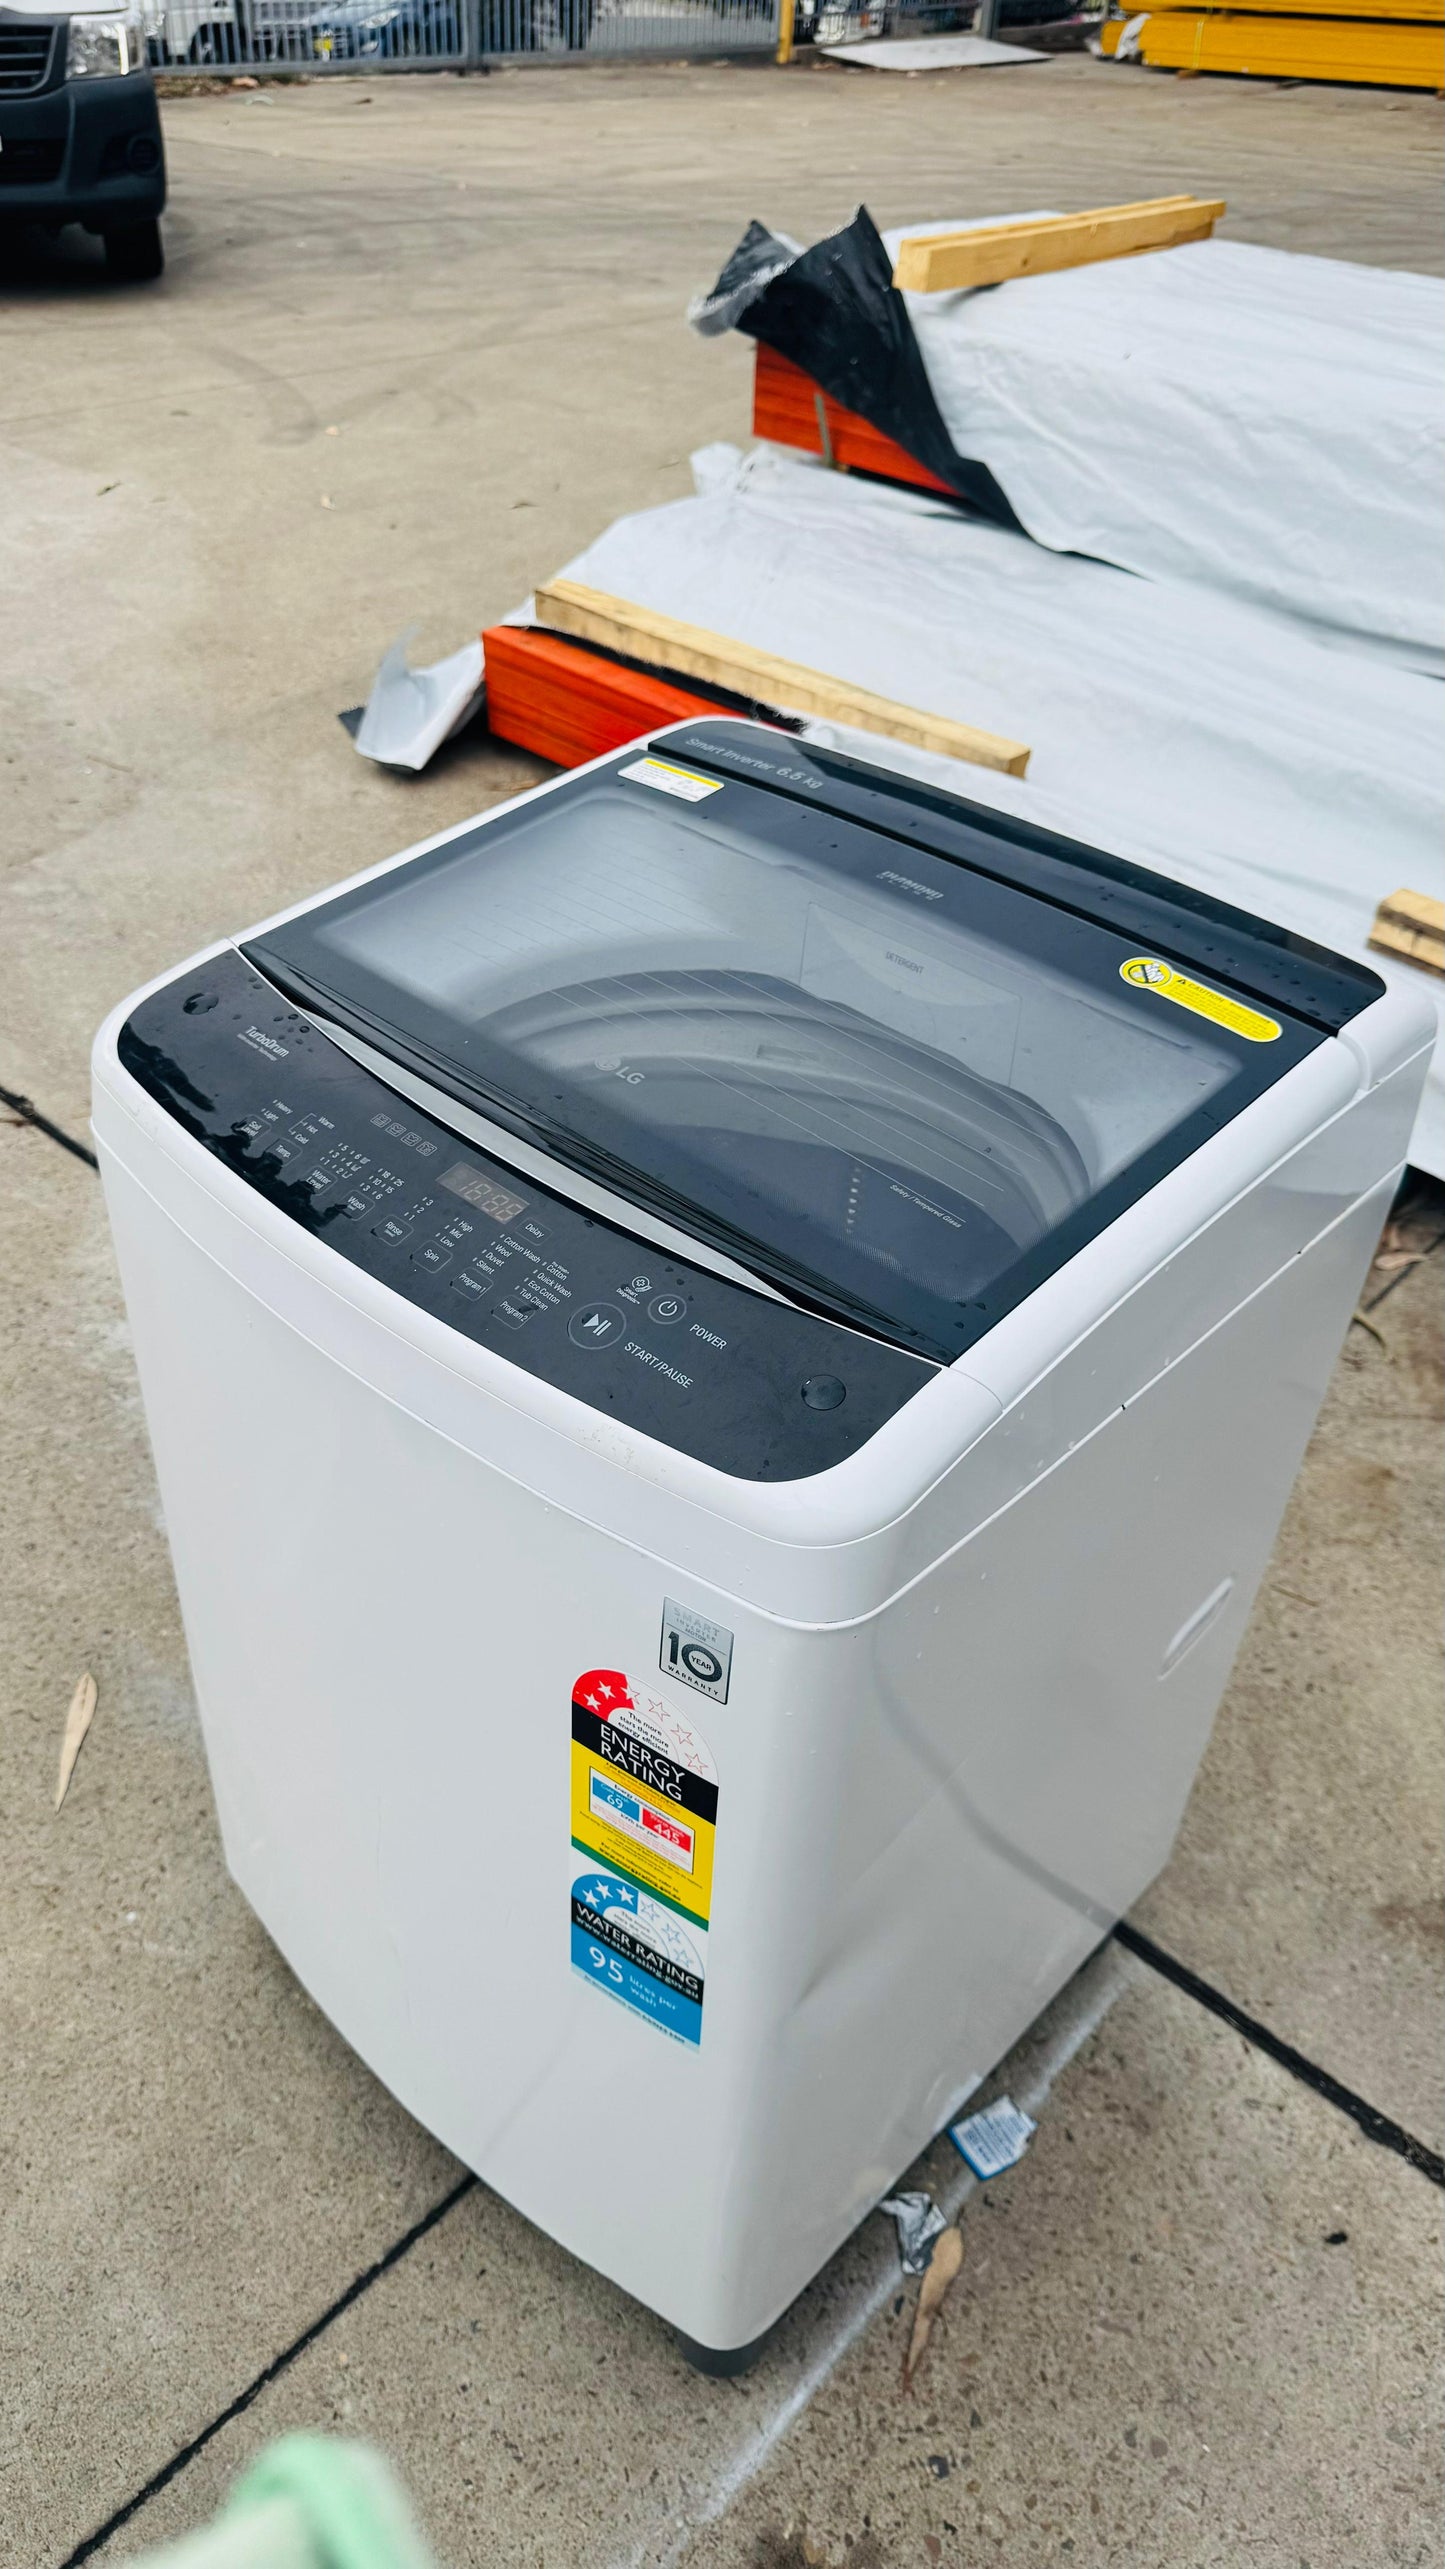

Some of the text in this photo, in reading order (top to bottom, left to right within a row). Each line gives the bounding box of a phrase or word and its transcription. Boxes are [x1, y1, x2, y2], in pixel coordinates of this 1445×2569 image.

[686, 738, 724, 754] Smart
[723, 750, 775, 770] Inverter
[803, 778, 824, 790] kg
[1188, 982, 1224, 1003] CAUTION
[245, 1025, 290, 1058] TurboDrum
[616, 1066, 645, 1084] LG
[263, 1110, 279, 1121] Light
[275, 1101, 293, 1115] Heavy
[306, 1125, 318, 1134] Hot
[318, 1116, 335, 1129] Warm
[295, 1133, 309, 1144] Cold
[305, 1176, 324, 1190] Level
[312, 1170, 331, 1185] Water
[372, 1178, 395, 1194] 10 15
[382, 1170, 405, 1187] 18 25
[347, 1196, 366, 1211] Wash
[890, 1185, 910, 1198] Safety
[913, 1197, 945, 1217] Tempered
[942, 1215, 962, 1228] Glass
[385, 1221, 403, 1236] Rinse
[449, 1228, 464, 1239] Mid
[459, 1220, 473, 1233] High
[525, 1223, 545, 1239] Delay
[440, 1236, 455, 1248] Low
[495, 1244, 513, 1258] Wool
[504, 1236, 541, 1264] Cotton Wash
[424, 1248, 440, 1262] Spin
[486, 1252, 505, 1267] Duvet
[476, 1260, 495, 1275] Silent
[546, 1264, 567, 1281] Cotton
[458, 1273, 482, 1291] Program
[537, 1272, 572, 1298] Quick Wash
[519, 1288, 549, 1312] Tub Clean
[527, 1280, 561, 1305] Eco Cotton
[500, 1301, 523, 1320] Program
[689, 1324, 727, 1350] POWER
[624, 1342, 694, 1389] START/PAUSE
[674, 1607, 720, 1637] SMART
[676, 1618, 717, 1642] INVERTER
[685, 1628, 707, 1642] MOTOR
[668, 1631, 722, 1682] 10
[691, 1655, 712, 1671] YEAR
[668, 1665, 718, 1695] WARRANTY
[620, 1716, 669, 1748] stars the more
[628, 1711, 662, 1736] The more
[618, 1722, 669, 1755] energy efficient
[601, 1723, 685, 1784] ENERGY
[601, 1742, 682, 1801] RATING
[613, 1783, 632, 1799] Energy
[607, 1794, 680, 1844] 69 445
[577, 1903, 631, 1948] WATER
[635, 1943, 699, 1990] RATING
[576, 1915, 699, 1999] www.waterrating.gov.au
[589, 1946, 623, 1983] 95
[629, 1975, 676, 2010] litres per
[630, 1986, 657, 2008] wash
